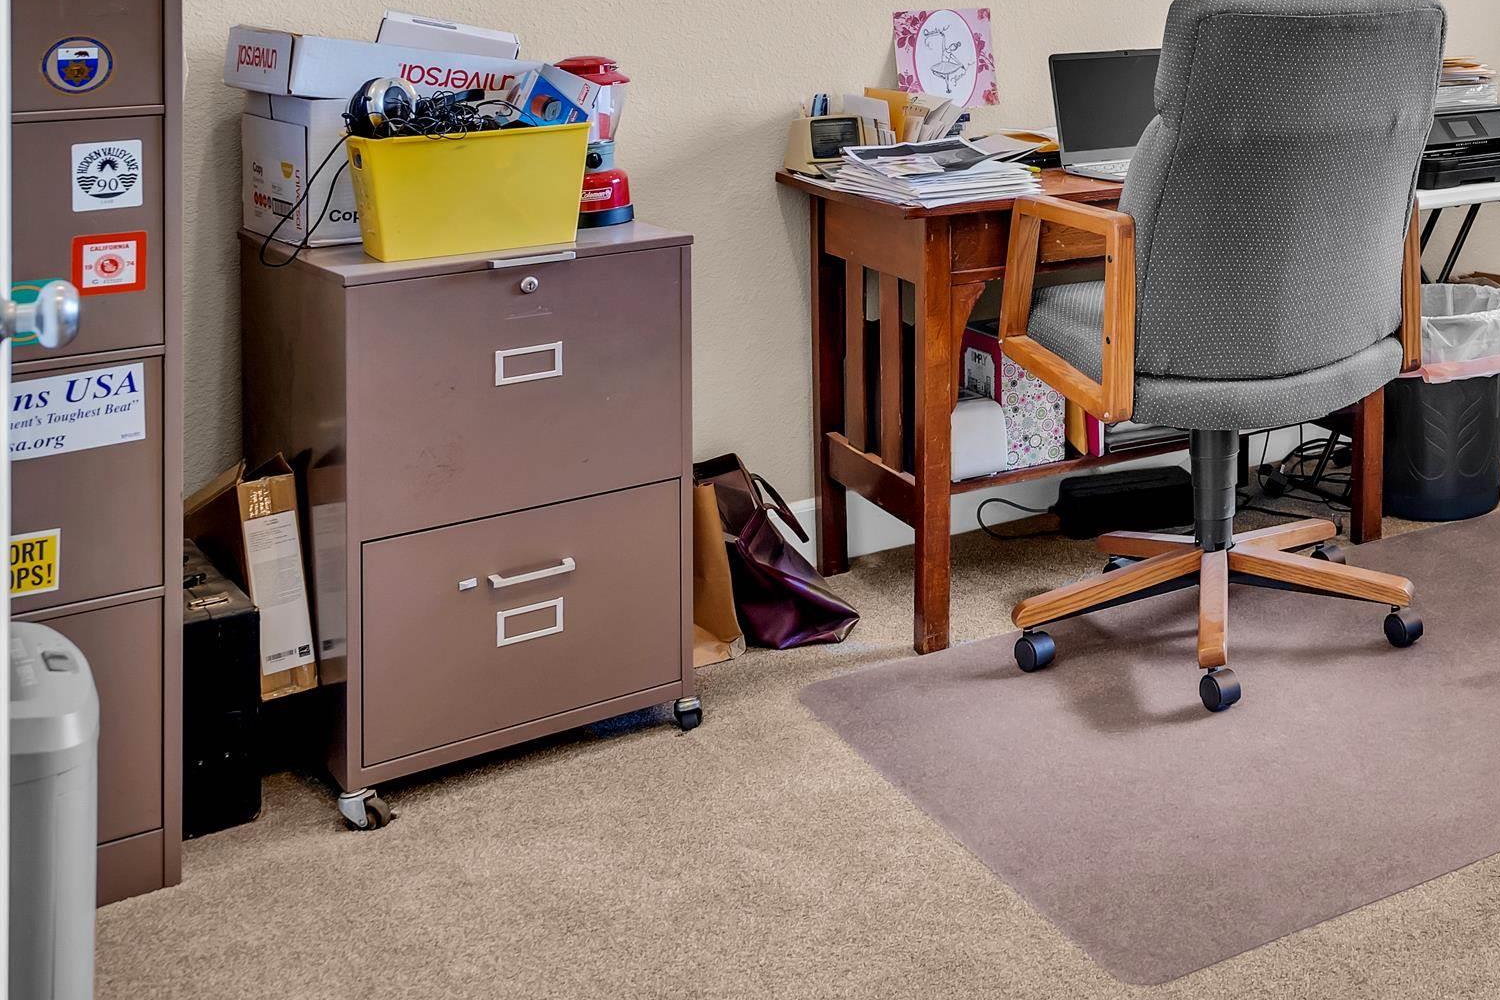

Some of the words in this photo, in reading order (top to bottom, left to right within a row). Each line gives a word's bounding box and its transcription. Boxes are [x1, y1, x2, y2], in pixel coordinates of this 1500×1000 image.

[236, 44, 278, 74] universal
[76, 149, 103, 175] HIDDEN
[101, 146, 128, 160] VALLEY
[123, 151, 140, 173] LAKE
[252, 161, 264, 177] Copy
[97, 178, 119, 192] 90
[294, 169, 303, 231] univsal
[90, 243, 130, 252] CALIFORNIA
[84, 263, 93, 271] 19
[126, 260, 135, 268] 74
[65, 369, 139, 403] USA
[47, 405, 101, 426] Toughest
